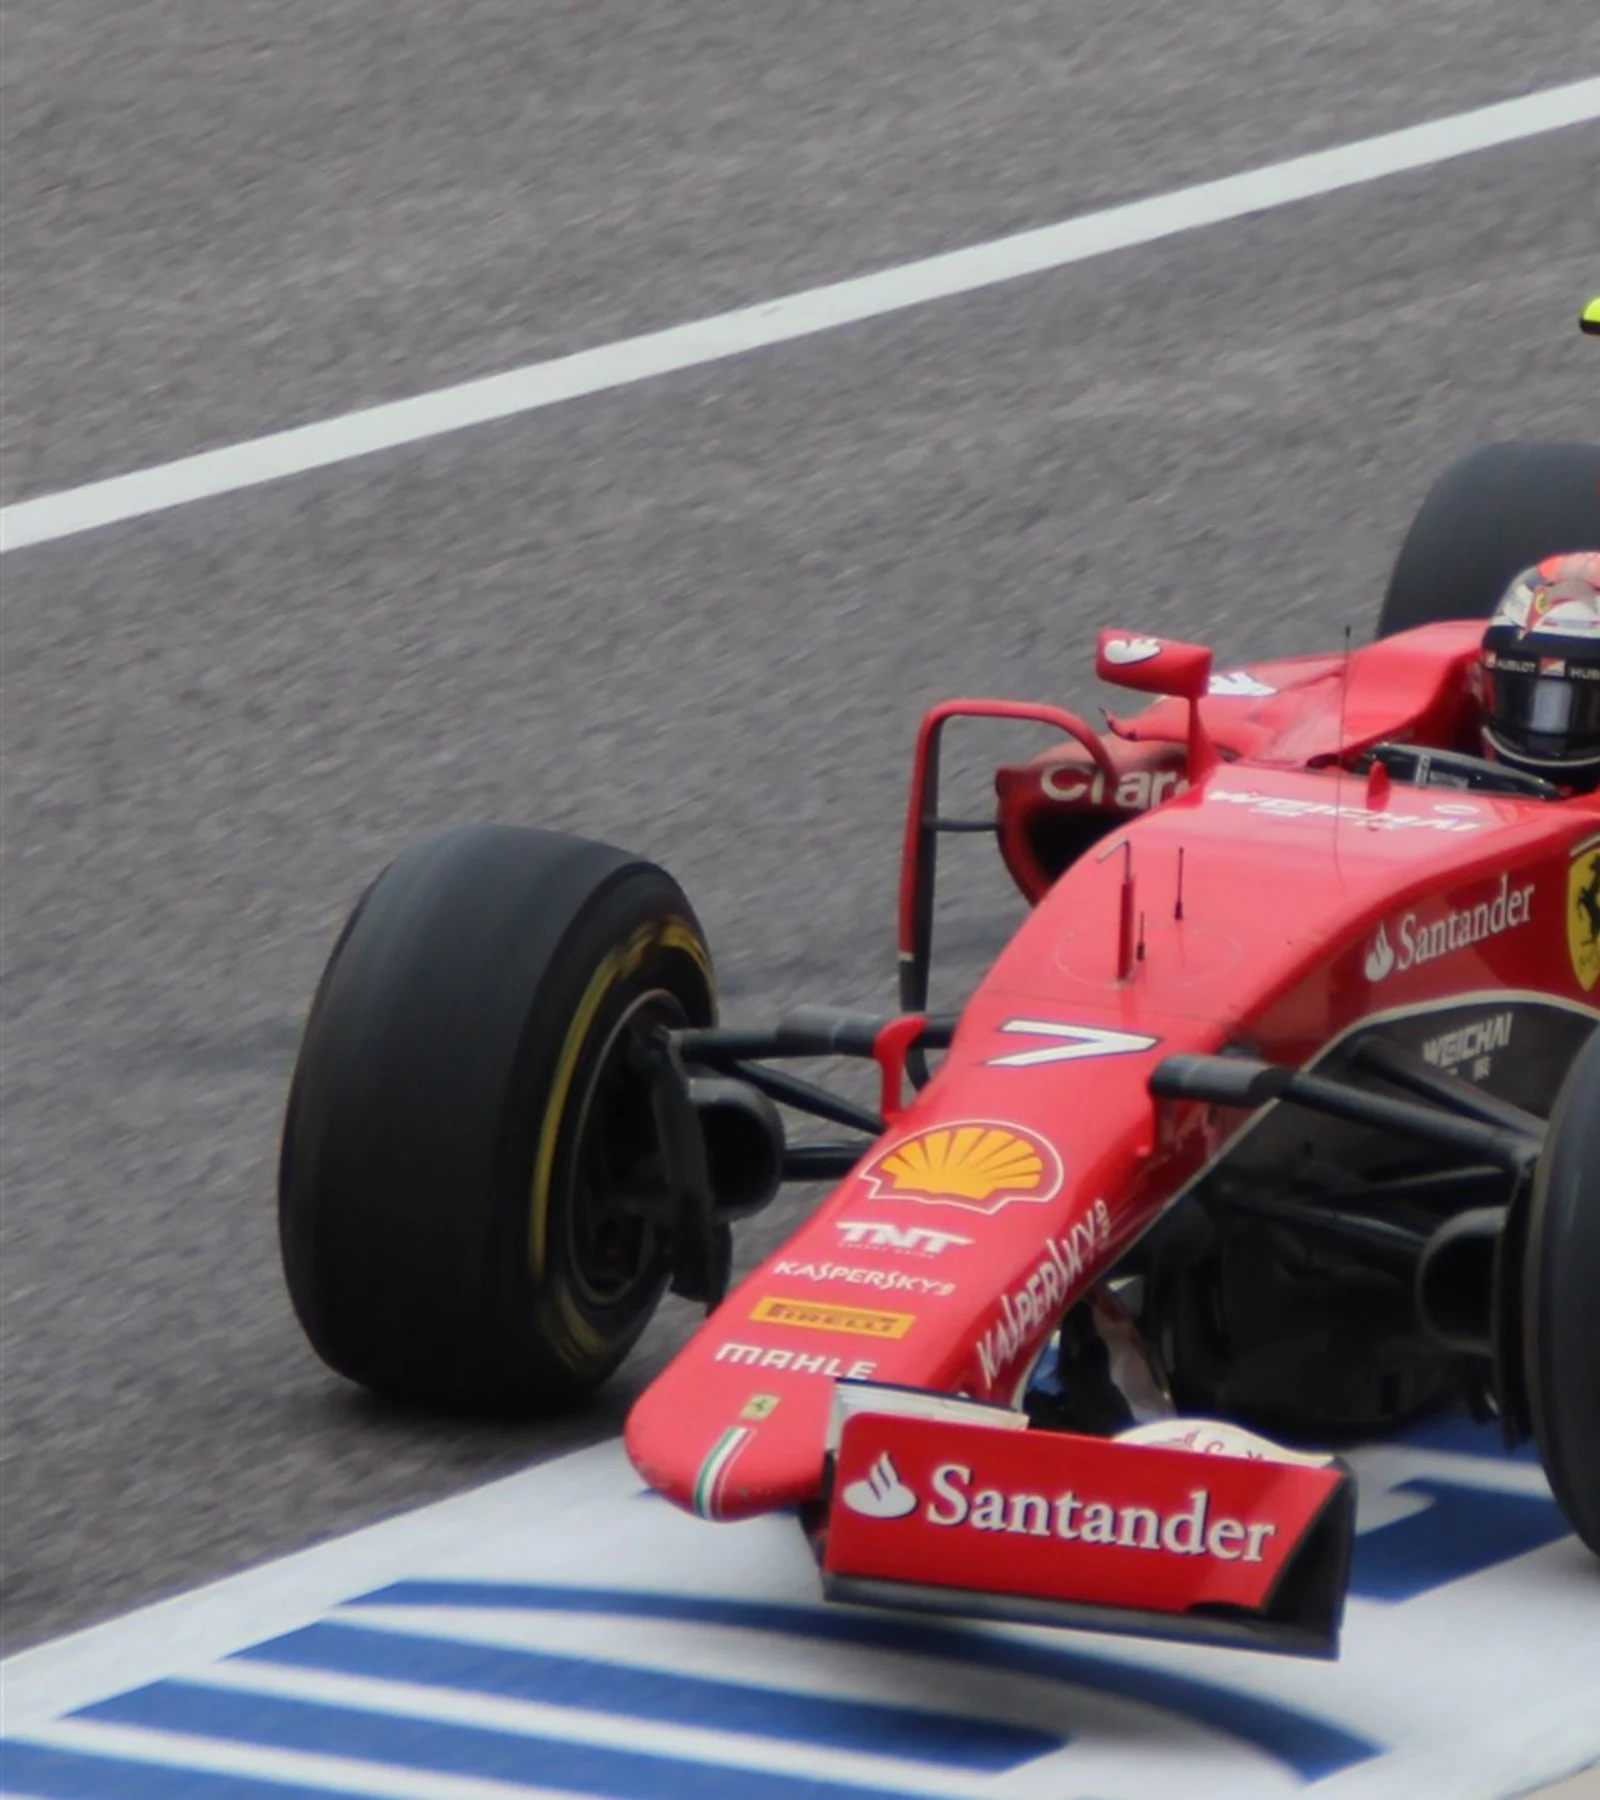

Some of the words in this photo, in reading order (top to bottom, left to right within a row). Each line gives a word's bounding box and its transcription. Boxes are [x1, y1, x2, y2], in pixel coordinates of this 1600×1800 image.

[1396, 872, 1536, 971] Santander
[980, 1015, 1162, 1069] 7
[1423, 1010, 1514, 1068] WEICHAI
[835, 1221, 975, 1255] TNT
[766, 1302, 900, 1333] PIRELLI
[714, 1342, 878, 1381] MAHLE
[926, 1463, 1276, 1563] Santander
